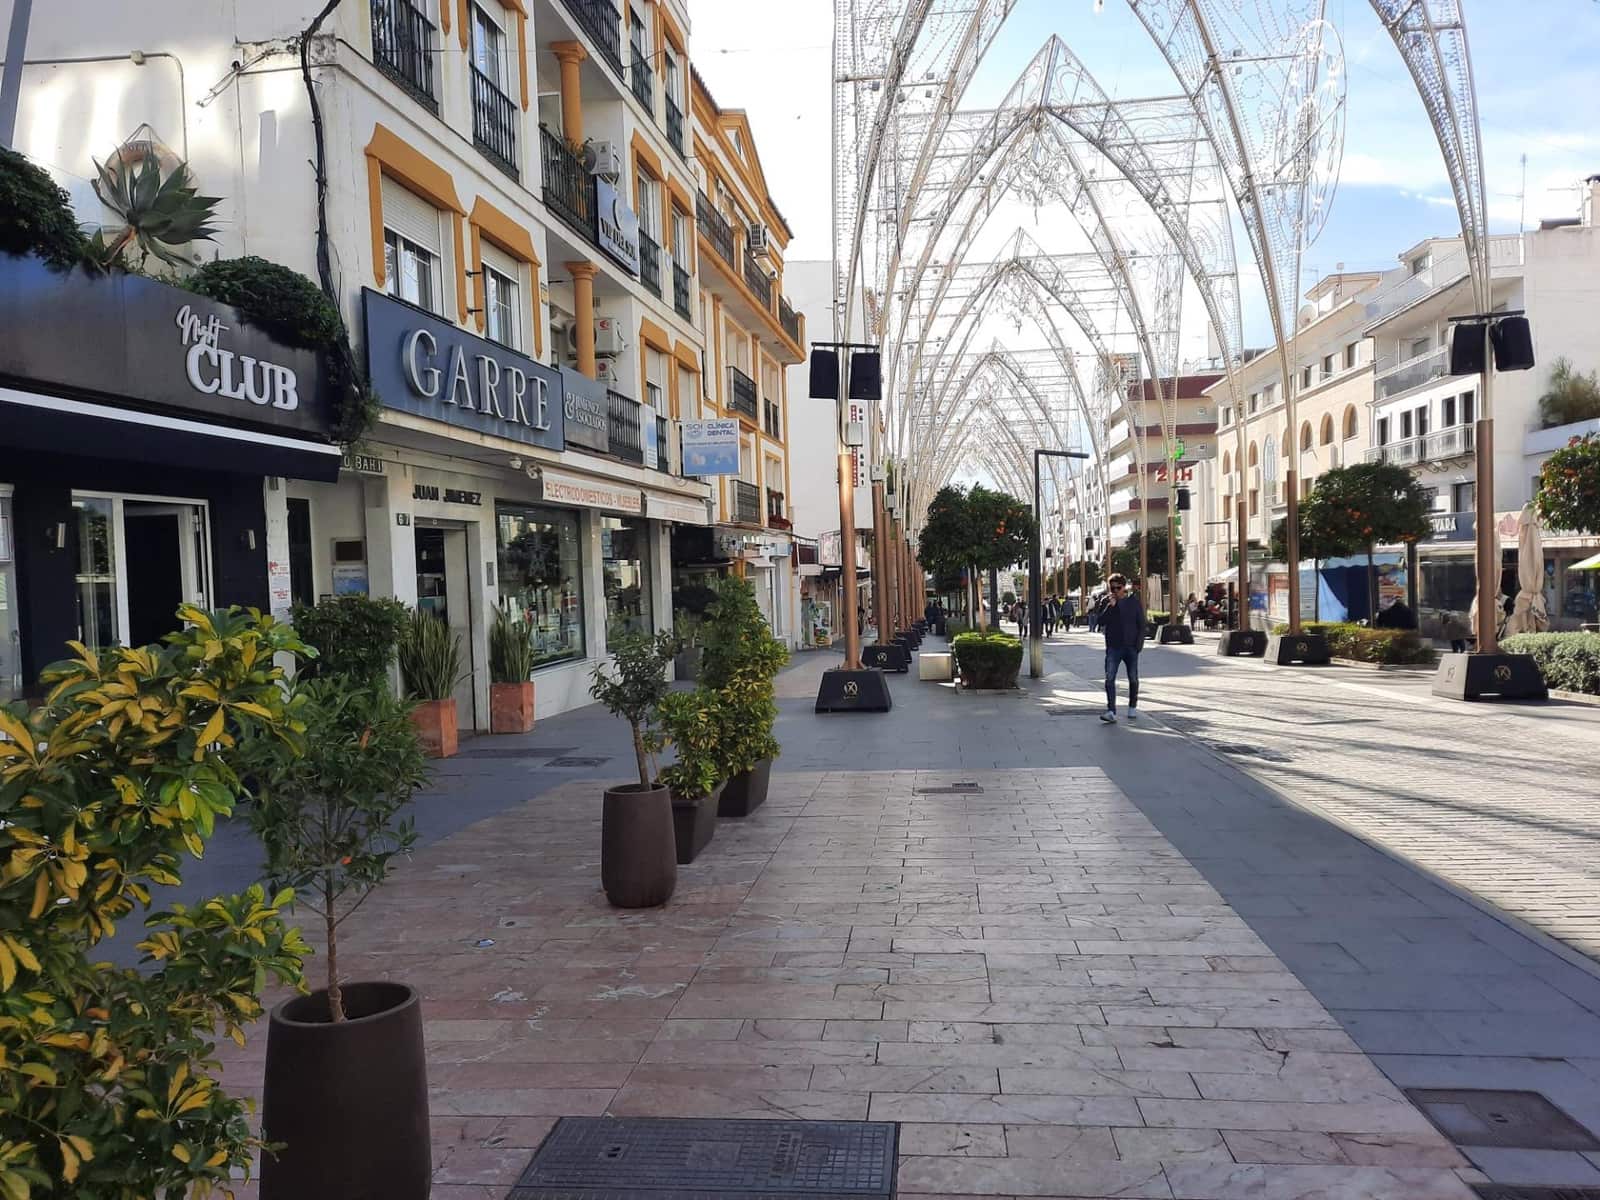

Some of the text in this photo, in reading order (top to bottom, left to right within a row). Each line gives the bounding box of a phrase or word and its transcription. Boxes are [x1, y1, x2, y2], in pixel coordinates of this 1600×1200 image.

[186, 344, 298, 410] CLUB
[402, 329, 552, 432] GARRE
[413, 485, 439, 501] JUAN
